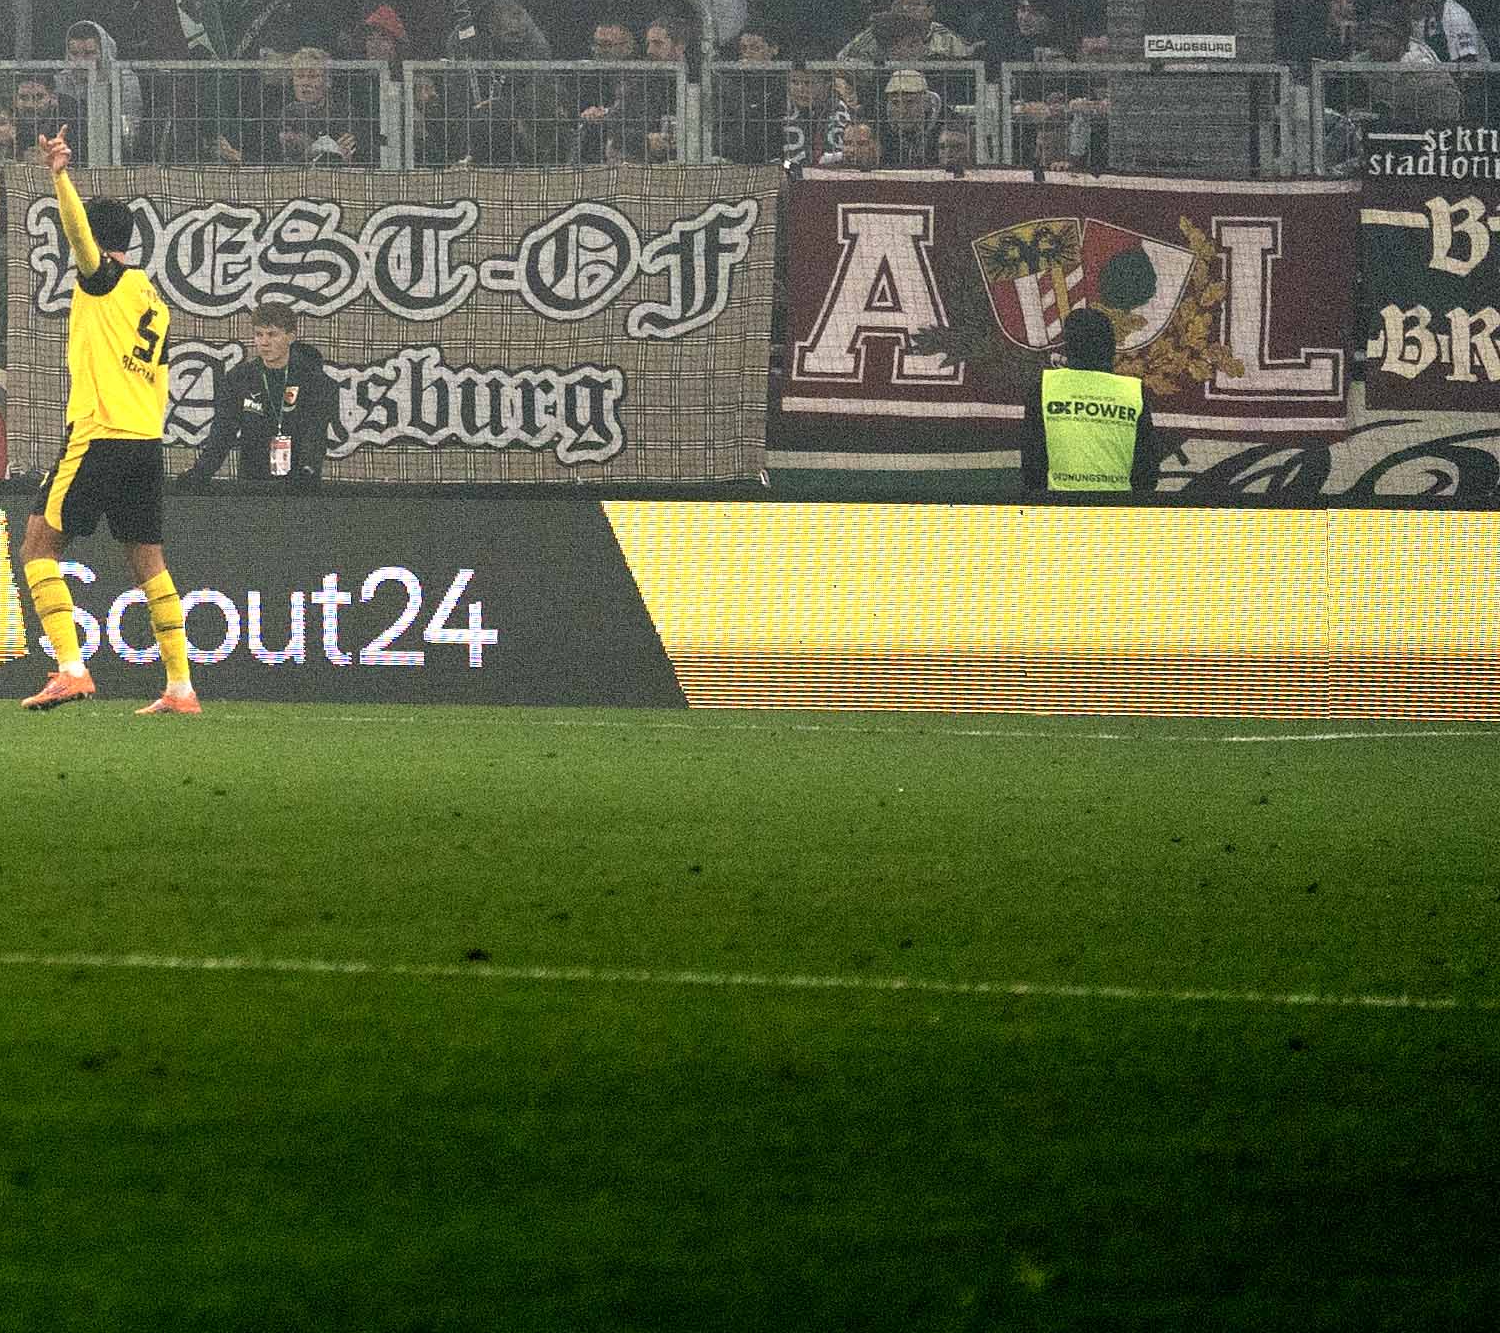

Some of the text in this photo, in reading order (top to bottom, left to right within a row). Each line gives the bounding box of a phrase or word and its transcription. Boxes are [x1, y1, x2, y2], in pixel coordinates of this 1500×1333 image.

[1368, 151, 1500, 179] stadion
[1074, 401, 1137, 422] POWER
[40, 560, 498, 668] Scout24
